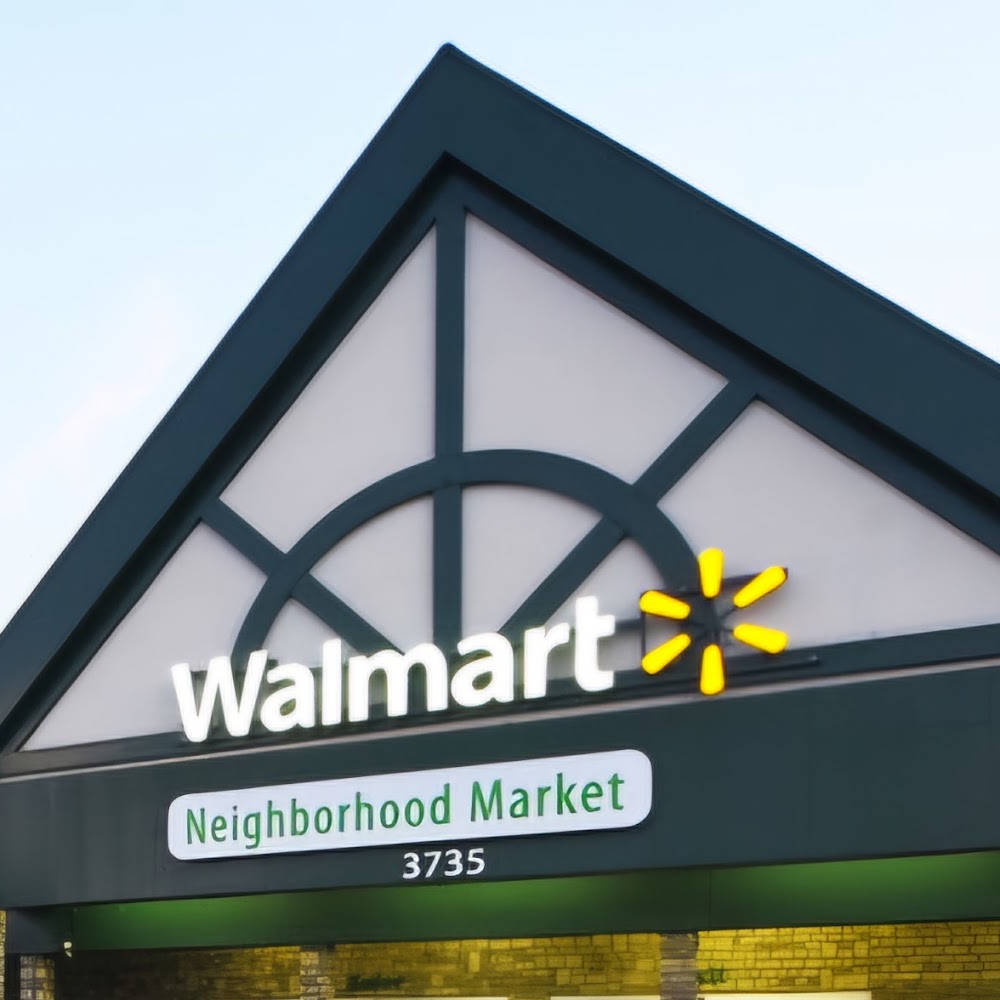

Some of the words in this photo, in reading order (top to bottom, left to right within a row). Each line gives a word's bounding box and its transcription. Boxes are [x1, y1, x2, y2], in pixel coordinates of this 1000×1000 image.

[170, 595, 615, 742] Walmart
[185, 783, 452, 849] Neighborhood
[470, 772, 625, 822] Market
[402, 847, 486, 879] 3735
